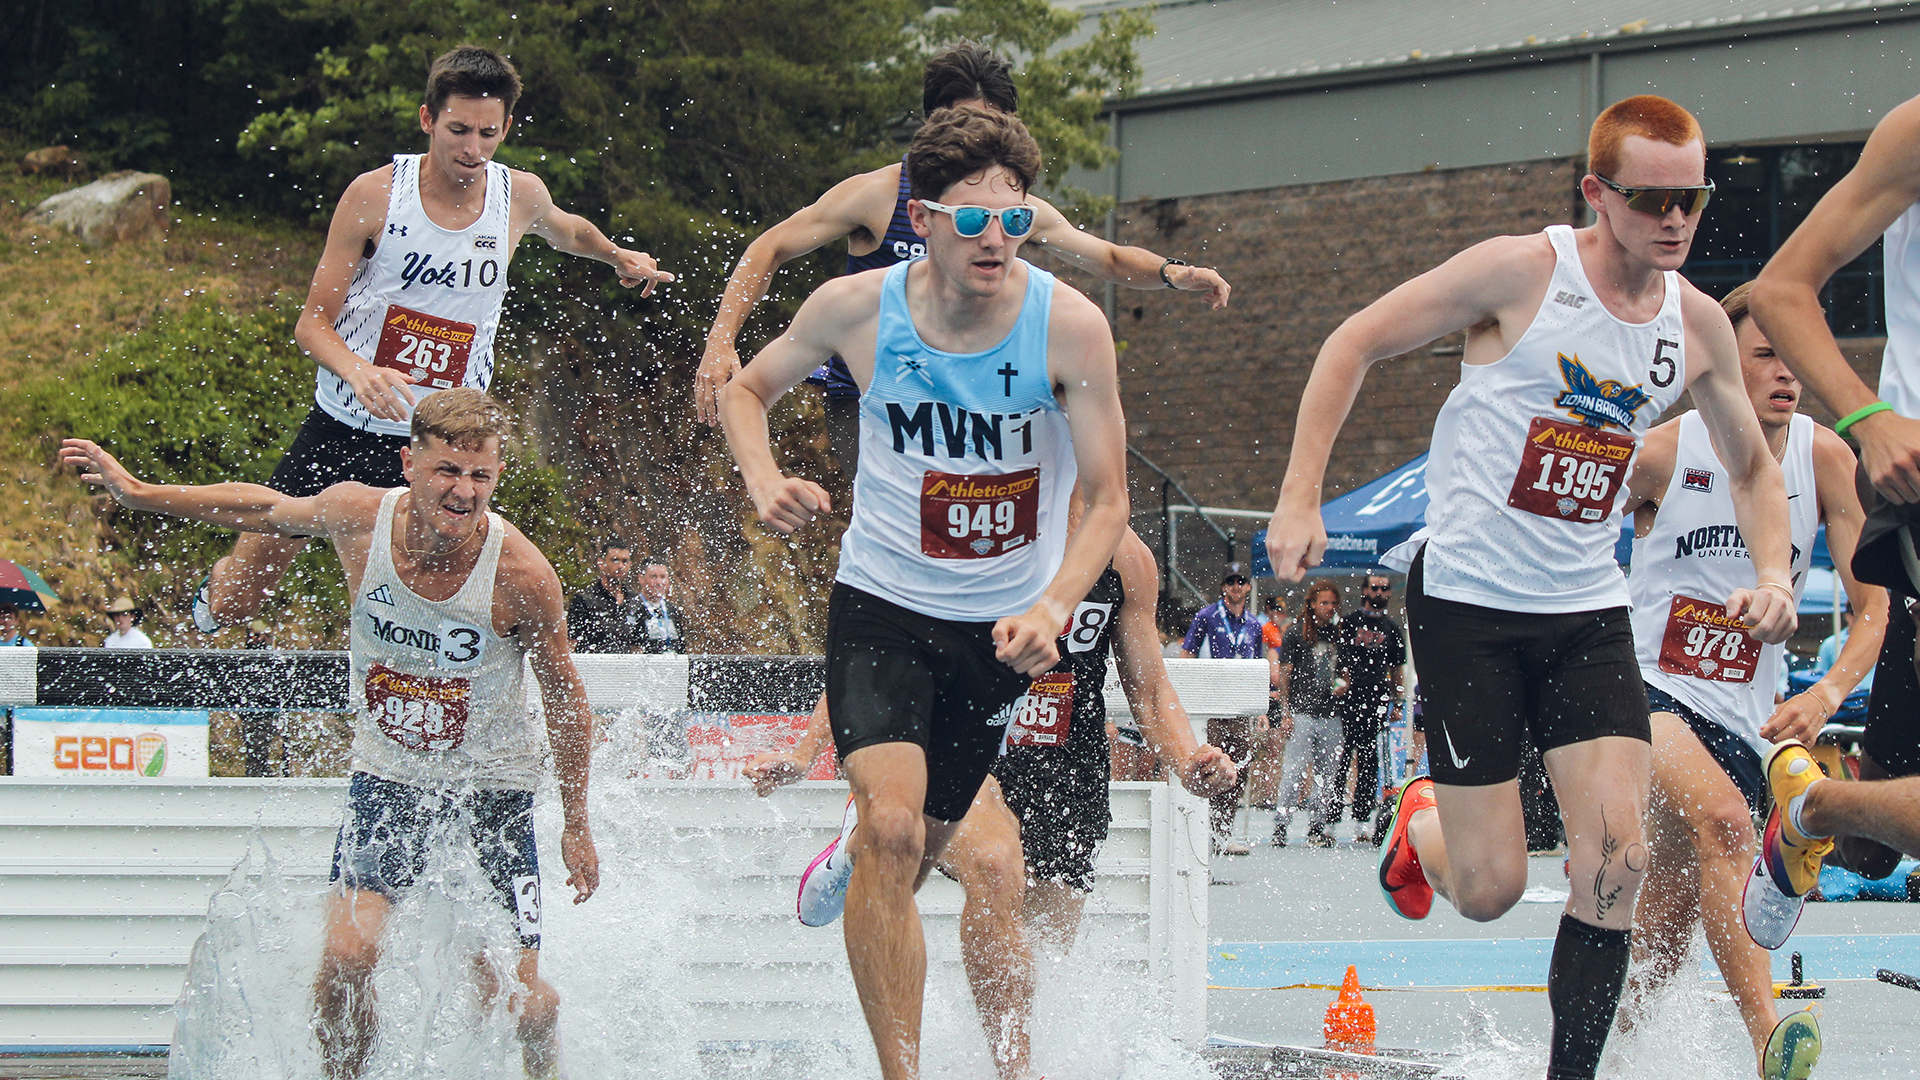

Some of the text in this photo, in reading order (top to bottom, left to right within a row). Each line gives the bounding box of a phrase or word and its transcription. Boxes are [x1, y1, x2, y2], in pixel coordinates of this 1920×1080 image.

[475, 240, 496, 248] CCC
[461, 259, 498, 287] 10
[1553, 290, 1588, 309] SAC
[388, 314, 450, 339] Athletic
[395, 334, 452, 373] 263
[1649, 338, 1678, 388] 5
[1560, 394, 1595, 410] JOHN
[1595, 397, 1632, 429] BROWN
[885, 402, 1041, 462] MVN
[1011, 420, 1032, 455] 1
[1532, 427, 1606, 456] Athletic
[1606, 446, 1629, 459] NET
[925, 479, 1033, 497] Athletic NET
[1532, 453, 1616, 501] 1395
[948, 501, 1015, 538] 949
[1698, 550, 1750, 559] UNIVER
[1073, 608, 1105, 644] 8
[1683, 626, 1743, 661] 978
[445, 628, 480, 662] 3
[1046, 683, 1070, 693] NET
[521, 881, 540, 924] 3
